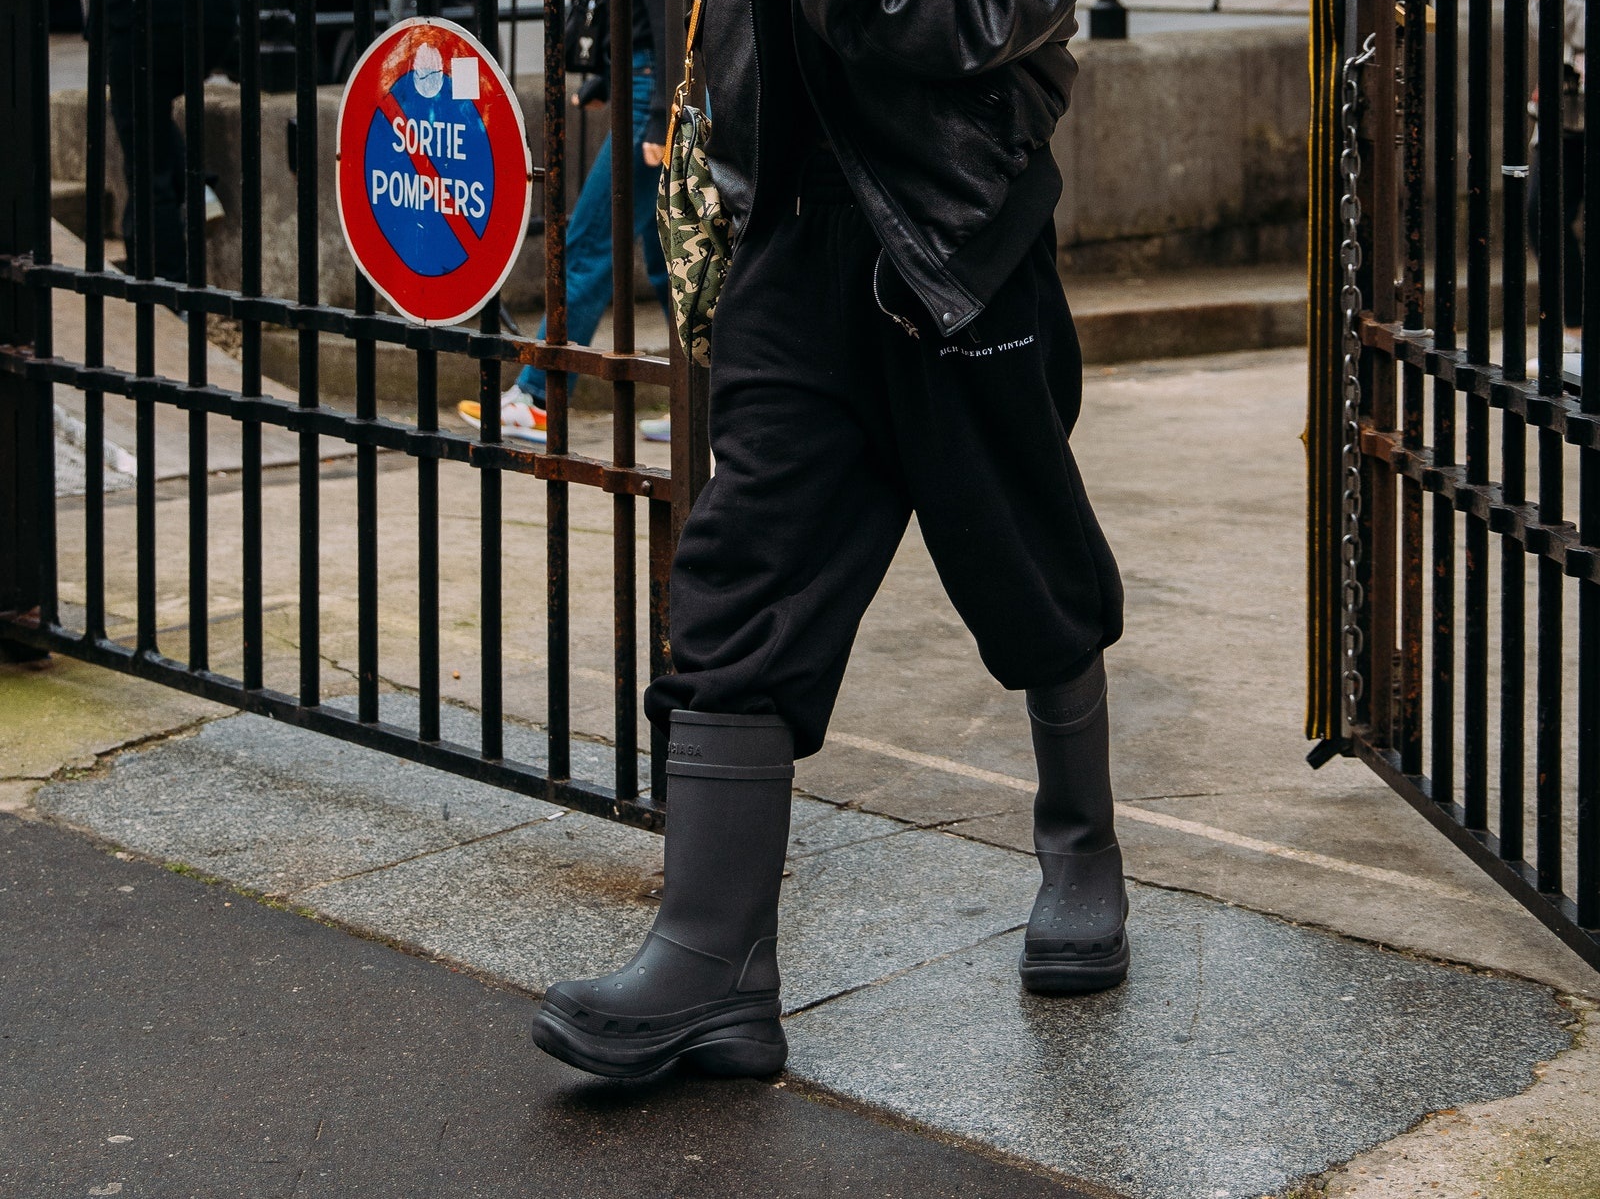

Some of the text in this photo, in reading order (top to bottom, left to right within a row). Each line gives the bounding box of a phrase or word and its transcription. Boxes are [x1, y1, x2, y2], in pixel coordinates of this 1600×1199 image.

[392, 116, 466, 160] SORTIE
[372, 169, 485, 218] POMPIERS
[997, 335, 1035, 352] VINTAGE
[669, 741, 704, 757] CIAGA
